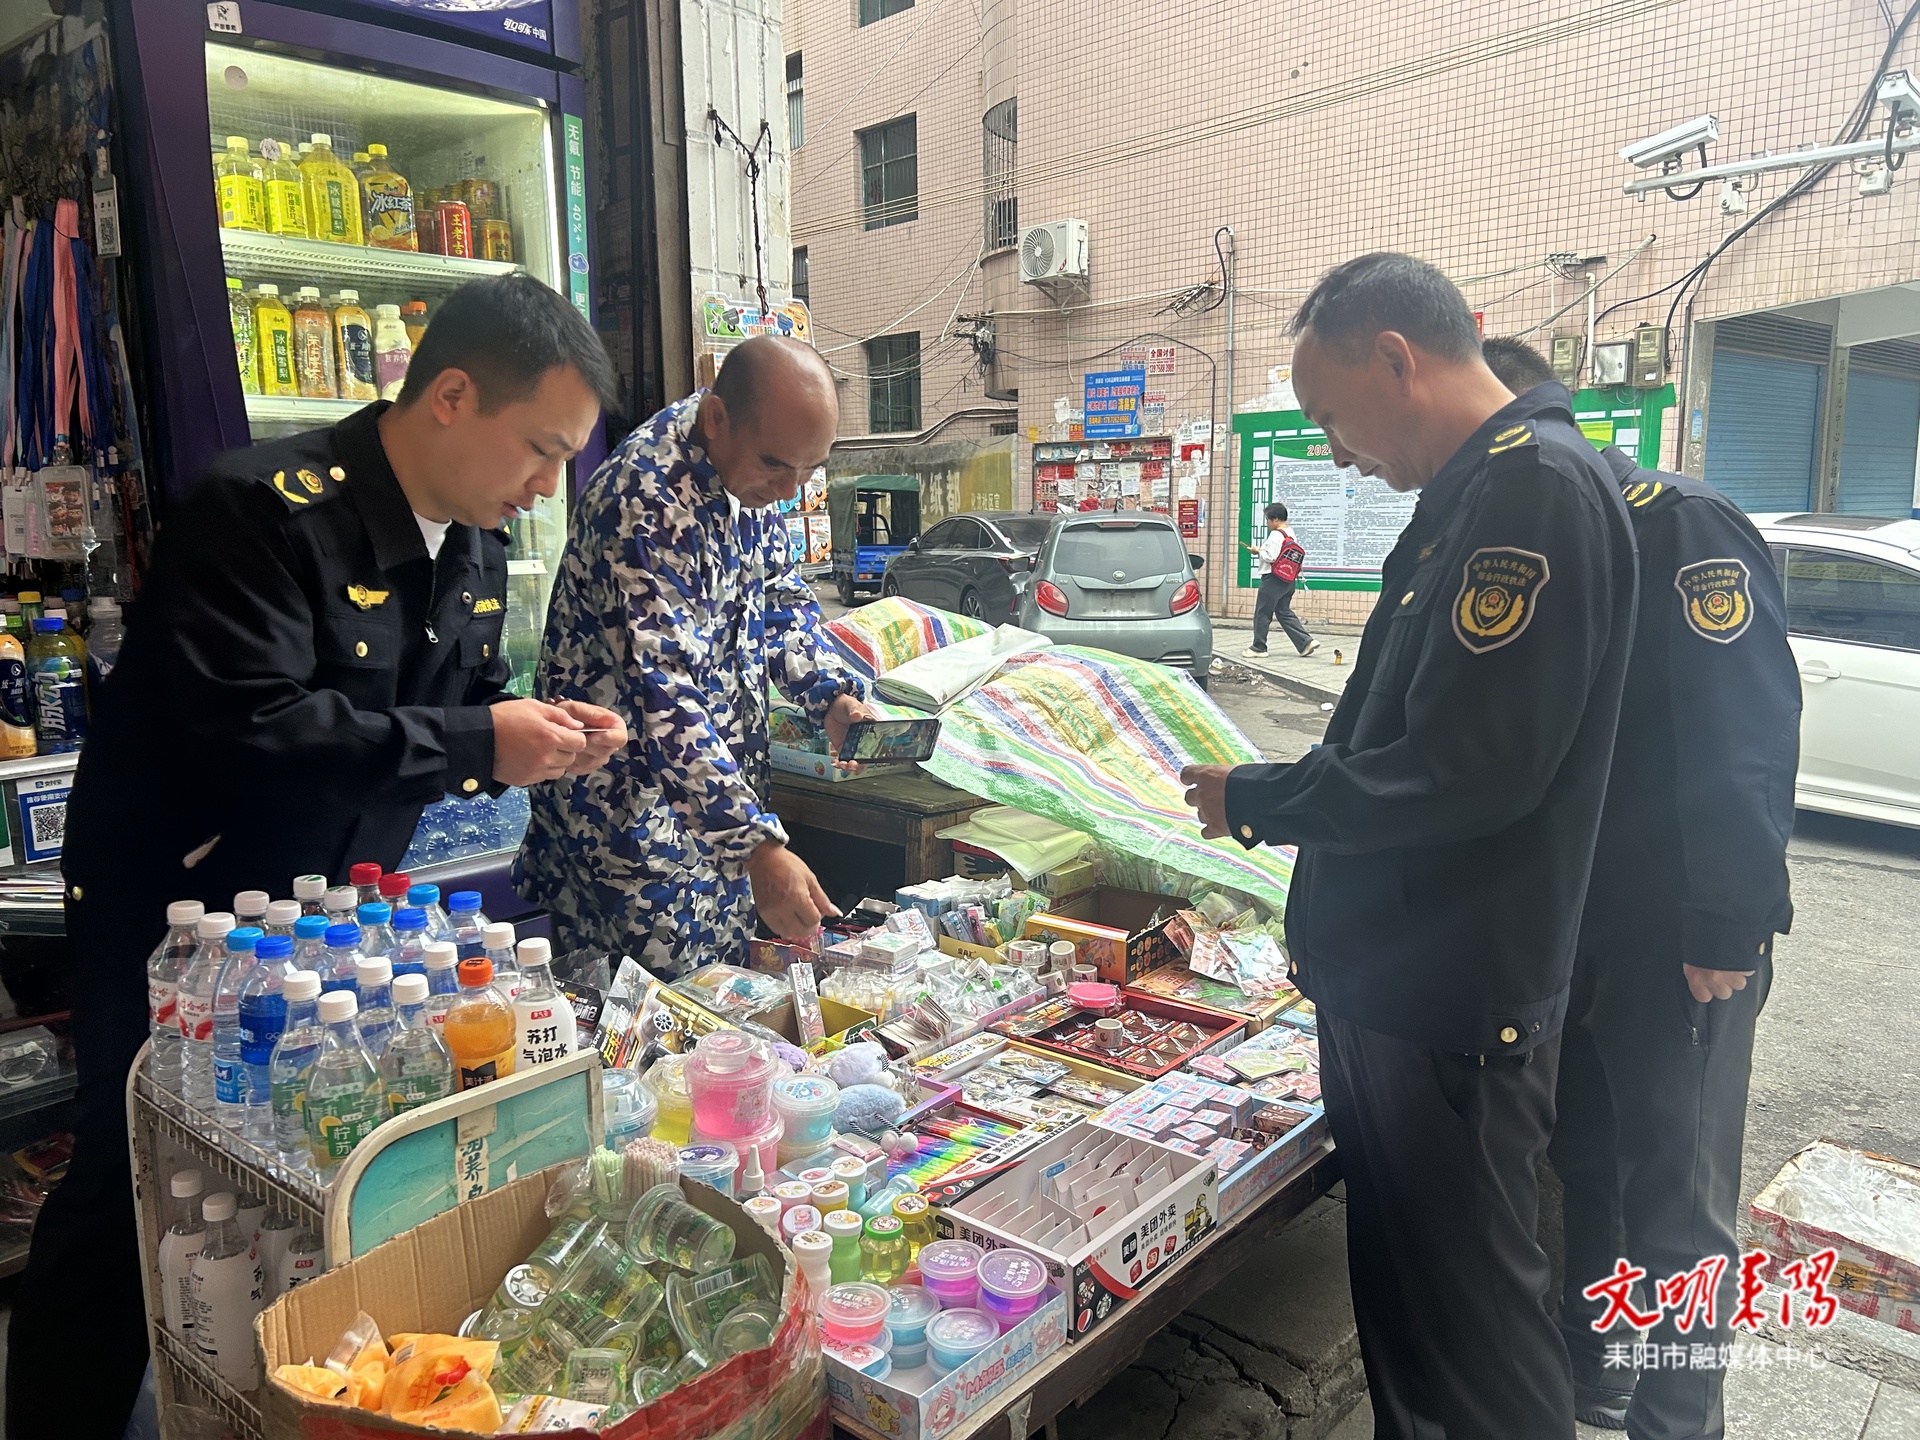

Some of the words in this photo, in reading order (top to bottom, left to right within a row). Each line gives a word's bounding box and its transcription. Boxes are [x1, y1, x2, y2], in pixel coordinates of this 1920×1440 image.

[567, 123, 581, 157] 无氟
[569, 164, 582, 197] 节能
[328, 183, 344, 232] 冰糖雪梨
[371, 191, 413, 215] 冰红茶
[451, 213, 465, 256] 王老吉
[275, 333, 289, 379] 冰糖雪梨
[1472, 558, 1538, 580] 中华人民共和国
[1476, 571, 1527, 587] 综合行政执法
[1682, 568, 1740, 588] 中华人民共和国
[1692, 578, 1737, 592] 综合行政执法
[30, 671, 67, 732] 脉动
[44, 779, 63, 787] 支付宝
[26, 790, 72, 804] 推荐使用支付
[526, 1025, 558, 1046] 苏打
[522, 1042, 568, 1064] 气泡水
[464, 1073, 495, 1087] 美汁源
[1140, 1202, 1177, 1241] 美团外卖
[1122, 1238, 1138, 1258] 美团
